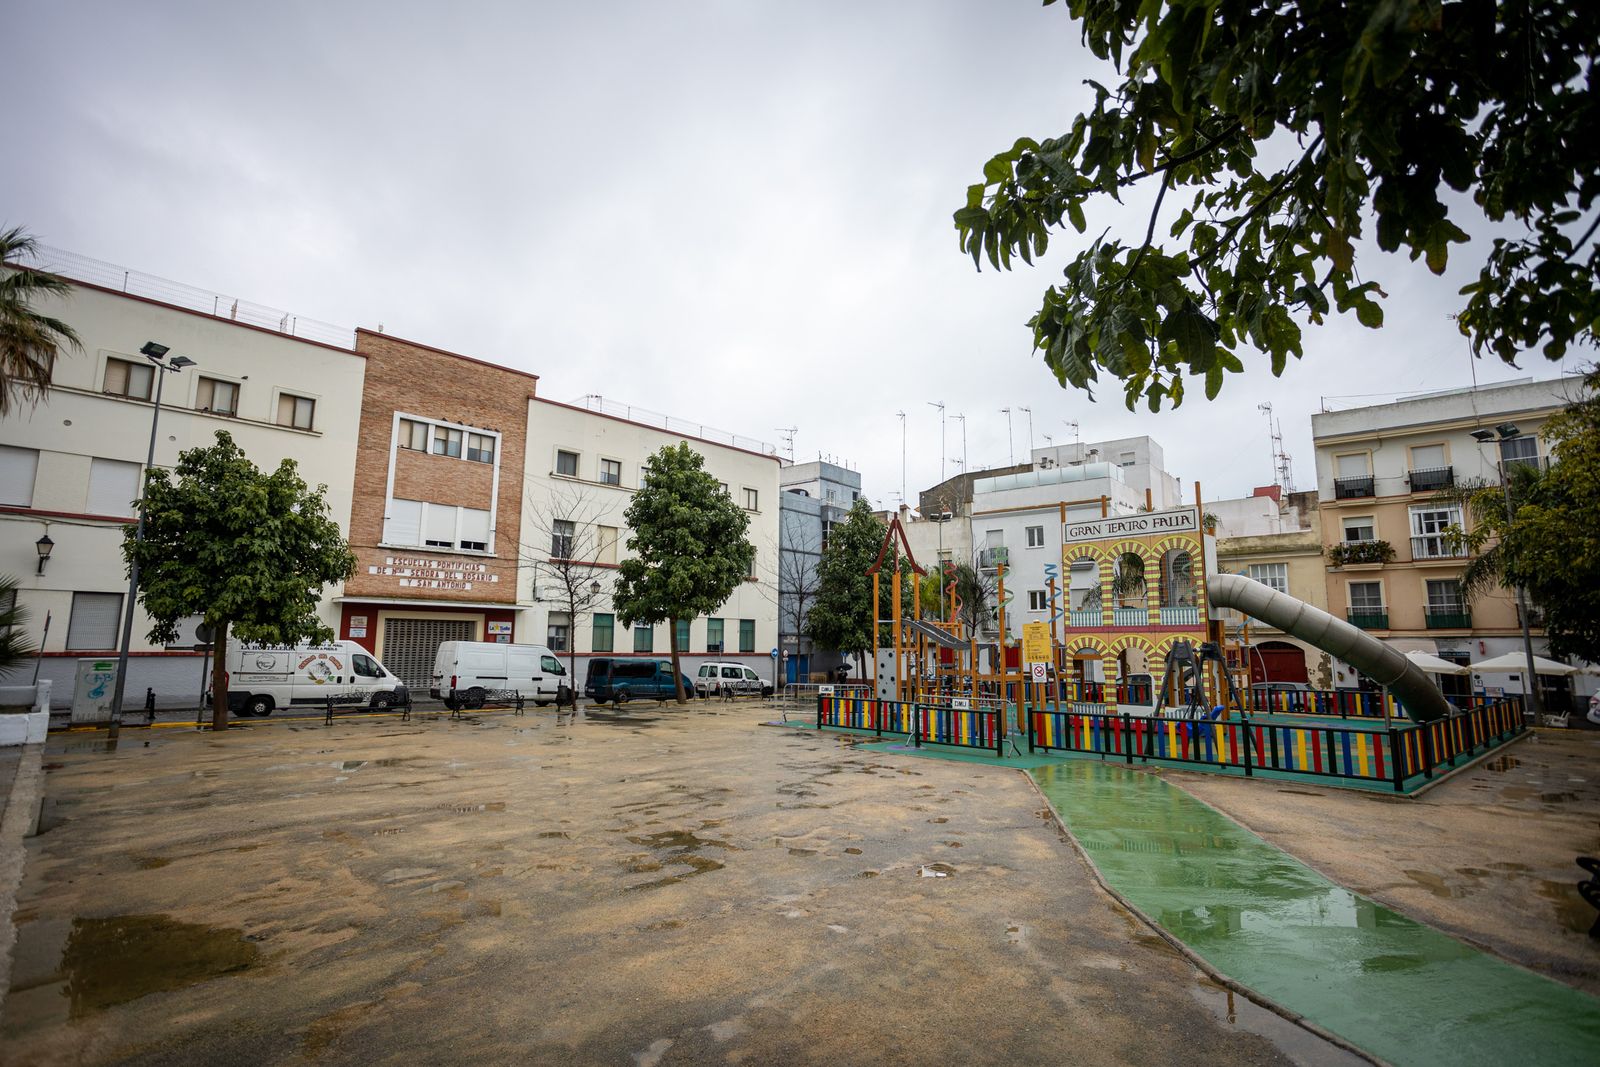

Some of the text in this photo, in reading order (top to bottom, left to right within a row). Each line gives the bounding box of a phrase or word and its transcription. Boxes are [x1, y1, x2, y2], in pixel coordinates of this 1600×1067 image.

[1069, 514, 1193, 537] GRAN TEATRO FALLA
[392, 557, 481, 572] ESCUELAS PONTIFICIAS
[376, 566, 387, 575] DE
[410, 568, 440, 578] SEÑORA
[444, 571, 458, 579] DEL
[462, 572, 493, 582] ROSARIO
[417, 579, 432, 588] SAN
[436, 580, 467, 590] ANTONIO
